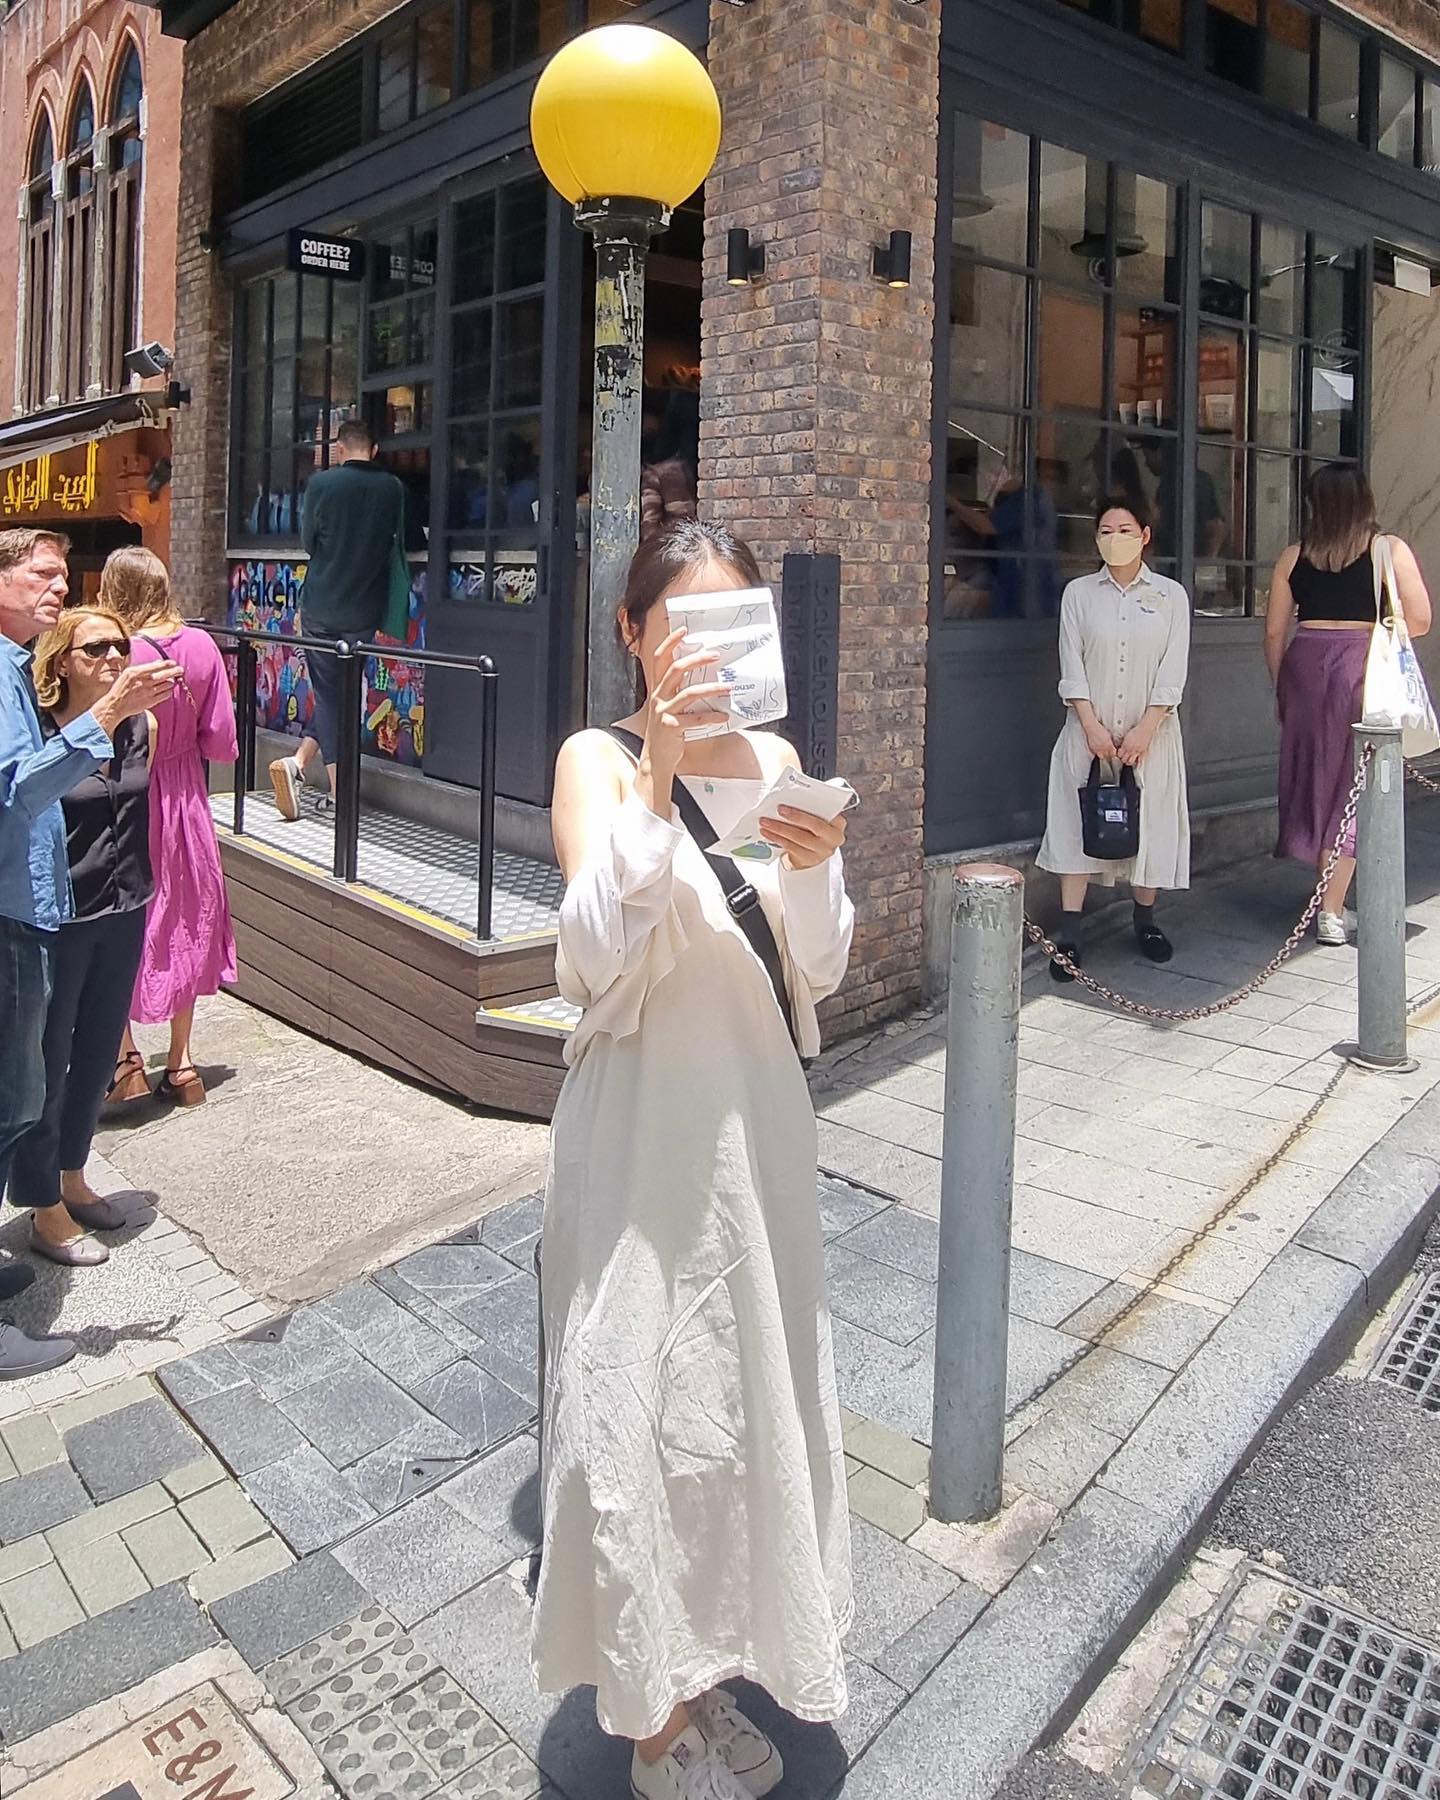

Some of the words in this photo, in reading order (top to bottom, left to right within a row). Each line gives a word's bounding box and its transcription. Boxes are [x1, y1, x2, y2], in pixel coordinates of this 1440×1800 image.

[300, 238, 351, 260] COFFEE?
[301, 255, 328, 268] ORDER
[329, 259, 350, 271] HERE
[238, 567, 297, 609] bakeh
[811, 580, 831, 781] bakehouse
